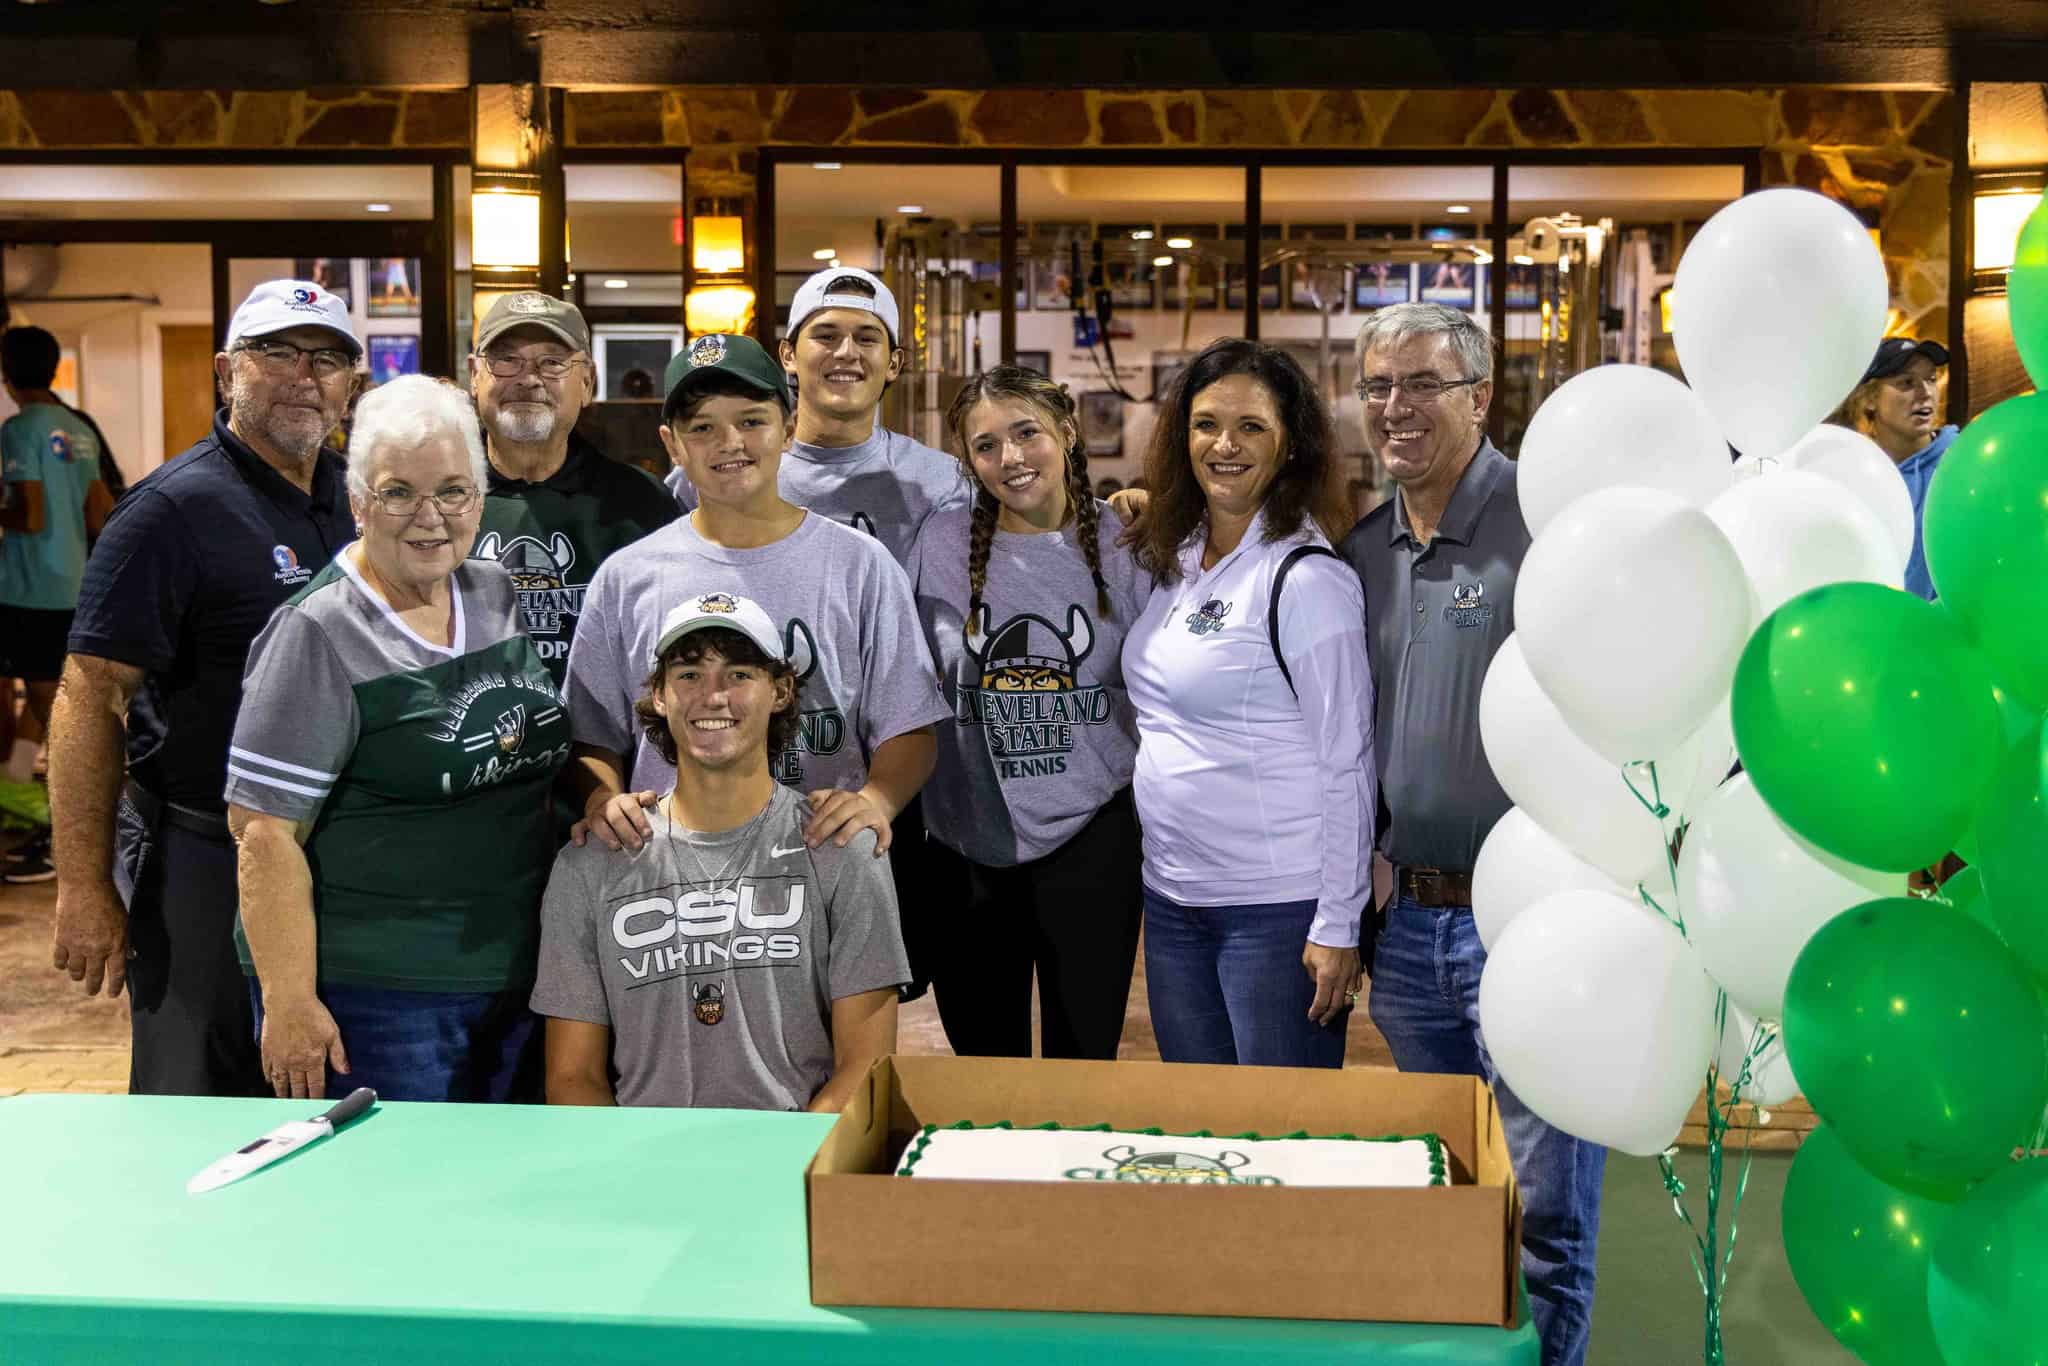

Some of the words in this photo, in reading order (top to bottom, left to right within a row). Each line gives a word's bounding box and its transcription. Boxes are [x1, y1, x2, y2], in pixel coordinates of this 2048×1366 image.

[956, 687, 1112, 726] CLEVELAND
[989, 722, 1073, 752] STATE
[1000, 756, 1067, 779] TENNIS
[612, 883, 805, 949] CSU
[619, 934, 802, 979] VIKINGS
